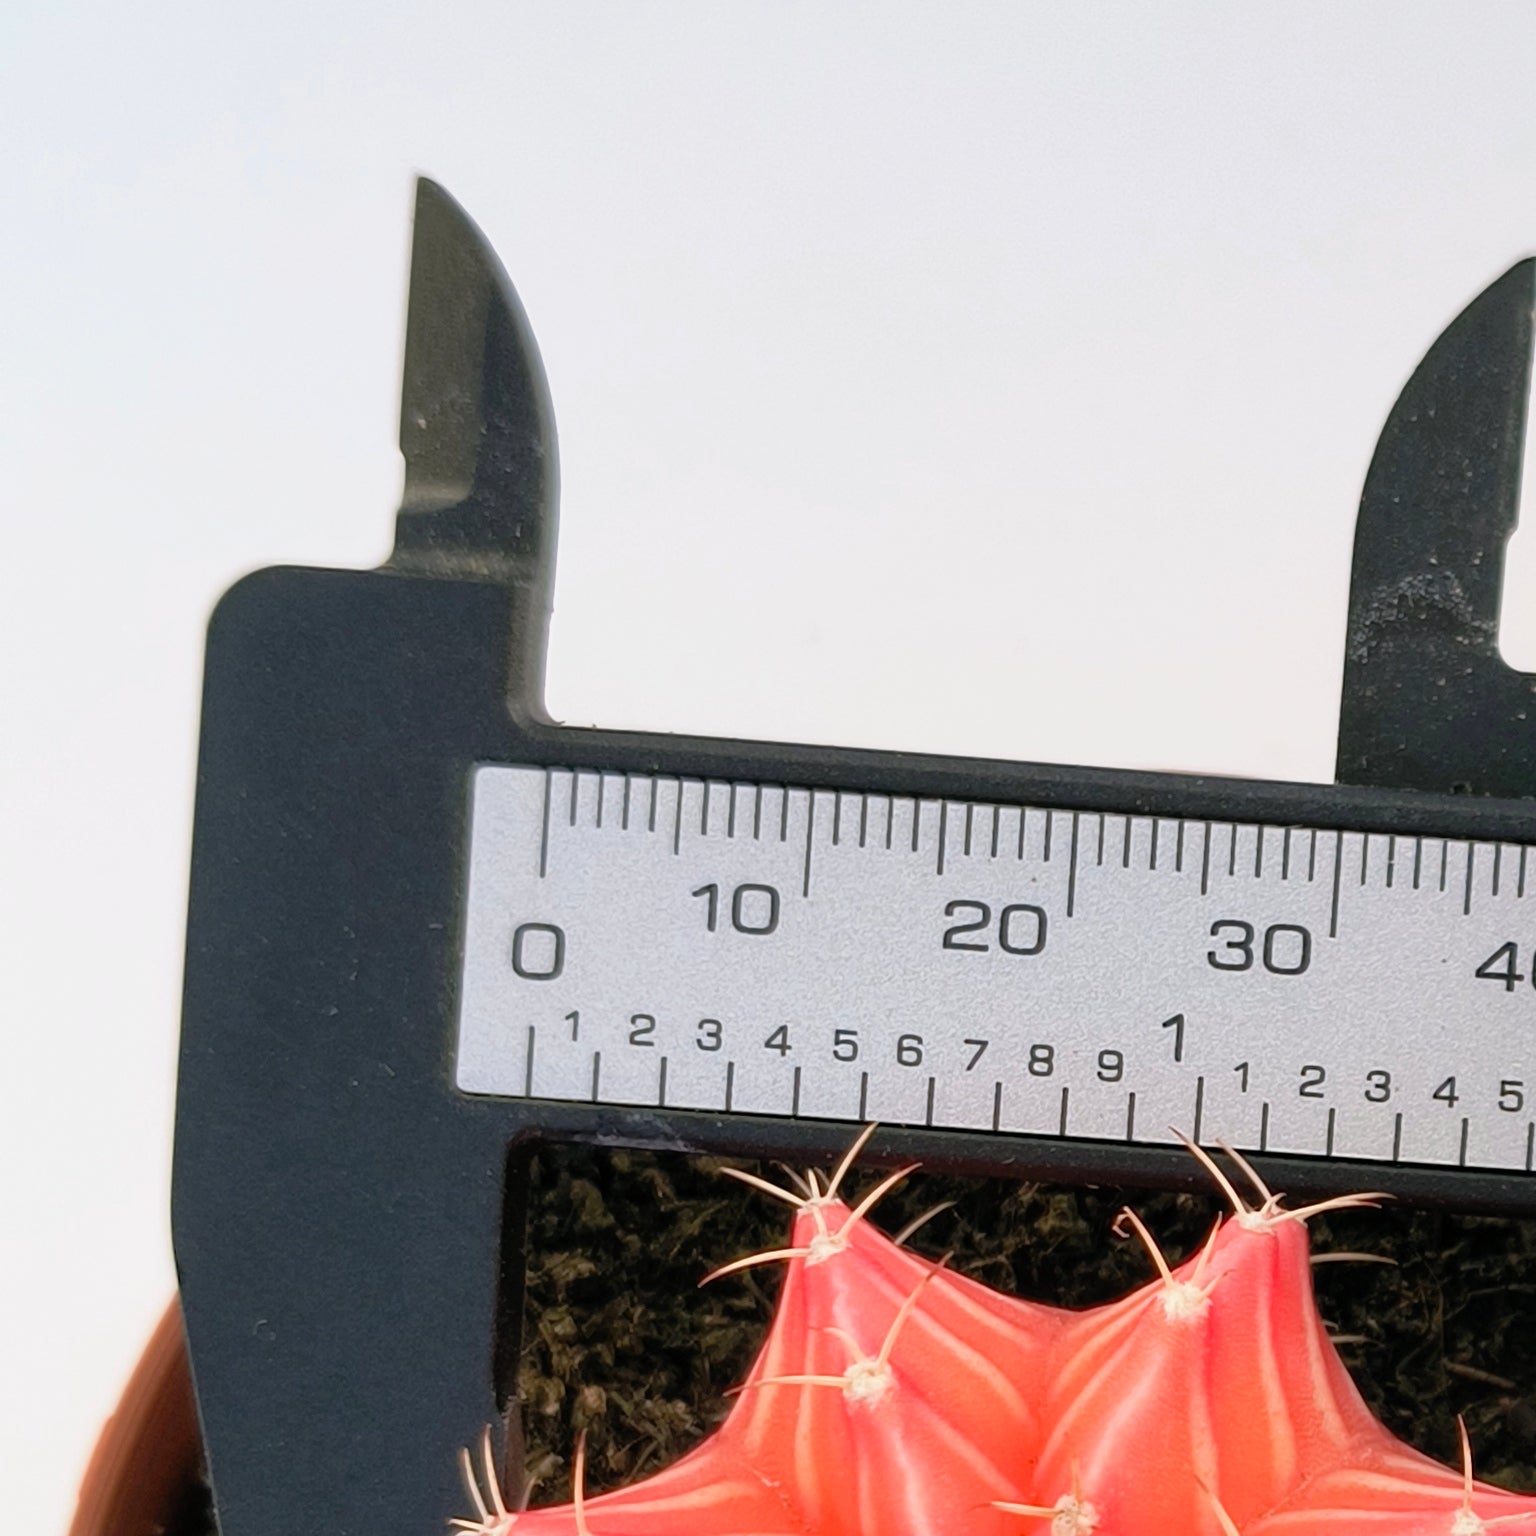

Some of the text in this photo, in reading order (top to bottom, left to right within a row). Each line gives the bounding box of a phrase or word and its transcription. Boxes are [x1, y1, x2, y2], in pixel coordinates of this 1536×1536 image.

[511, 922, 567, 981] 0
[691, 882, 781, 936] 10
[941, 899, 1049, 956] 20
[1206, 919, 1312, 976] 30
[563, 1010, 581, 1042] 1
[628, 1013, 656, 1047] 2
[695, 1018, 723, 1052] 3
[764, 1024, 793, 1057] 4
[832, 1028, 859, 1062] 5
[896, 1033, 924, 1068] 6
[962, 1038, 989, 1072] 7
[1027, 1043, 1055, 1078] 8
[1096, 1048, 1124, 1083] 9
[1161, 1013, 1185, 1063] 1
[1233, 1061, 1250, 1093] 1
[1298, 1064, 1326, 1099] 2
[1364, 1069, 1392, 1104] 3
[1431, 1075, 1460, 1109] 4
[1497, 1079, 1524, 1113] 5
